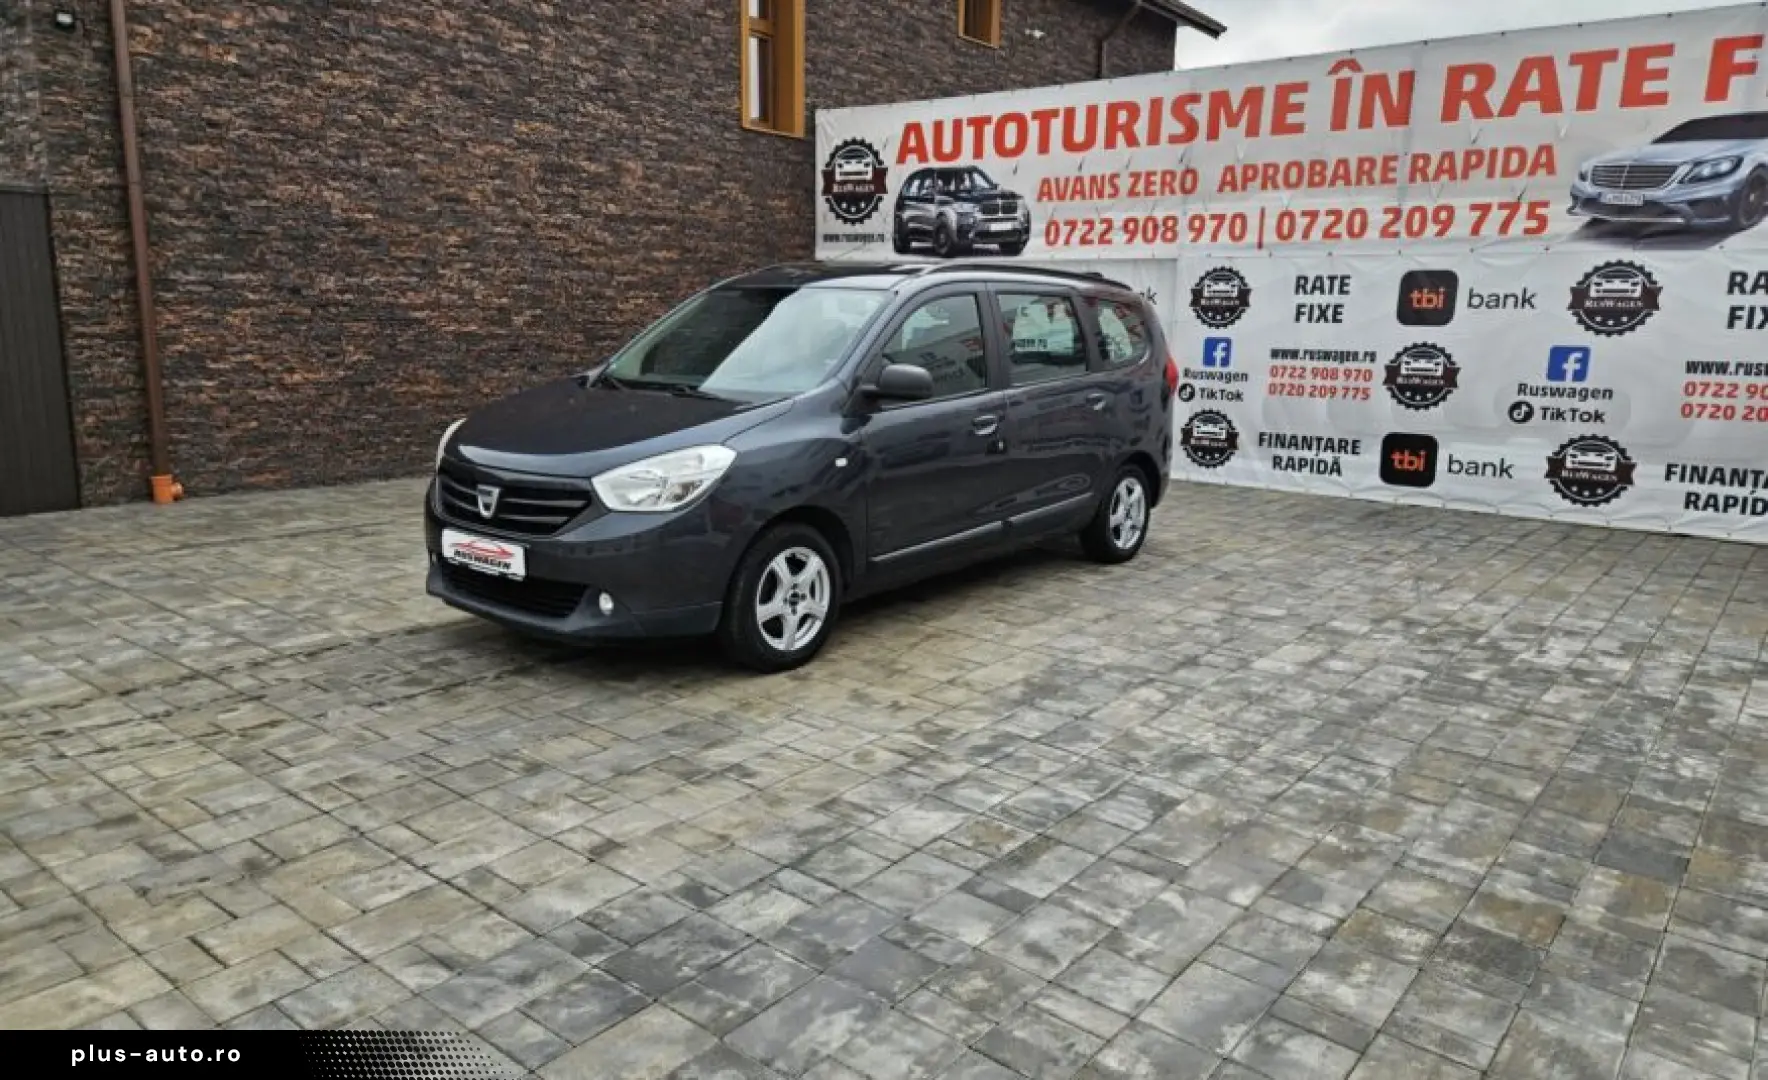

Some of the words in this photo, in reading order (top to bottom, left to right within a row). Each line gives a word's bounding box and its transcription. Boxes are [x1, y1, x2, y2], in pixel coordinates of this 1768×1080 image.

[896, 81, 1308, 165] AUTOTURISME
[1328, 58, 1415, 132] ÎN
[1440, 43, 1675, 123] RATE
[1704, 33, 1768, 101] F
[1037, 173, 1120, 202] AVANS
[1127, 168, 1198, 198] ZERO
[1216, 155, 1399, 194] APROBARE
[1408, 143, 1556, 184] RAPIDA
[1044, 217, 1114, 246] 0722
[1122, 214, 1179, 245] 908
[1187, 211, 1248, 243] 970
[1275, 207, 1370, 241] 0720
[1379, 205, 1455, 239] 209
[1469, 201, 1550, 237] 775
[1294, 274, 1351, 296] RATE
[1726, 270, 1768, 295] RA
[1410, 286, 1445, 309] tbi
[1467, 287, 1537, 310] bank
[1294, 303, 1344, 324] FIXE
[1269, 348, 1377, 364] www.ruswagen.ro
[1183, 367, 1248, 384] Ruswagen
[1269, 365, 1307, 380] 0722
[1311, 366, 1339, 381] 908
[1343, 368, 1373, 382] 970
[1685, 361, 1768, 376] www.rus
[1199, 387, 1244, 402] TikTok
[1268, 383, 1305, 397] 0720
[1308, 385, 1337, 399] 209
[1341, 386, 1371, 401] 775
[1517, 383, 1613, 402] Ruswagen
[1684, 381, 1739, 398] 0722
[1540, 406, 1606, 423] TikTok
[1680, 403, 1736, 420] 0720
[1741, 405, 1768, 422] 20
[1272, 454, 1342, 477] RAPIDĂ
[1391, 449, 1426, 472] tbi
[1447, 453, 1515, 479] bank
[1684, 492, 1768, 516] RAPID
